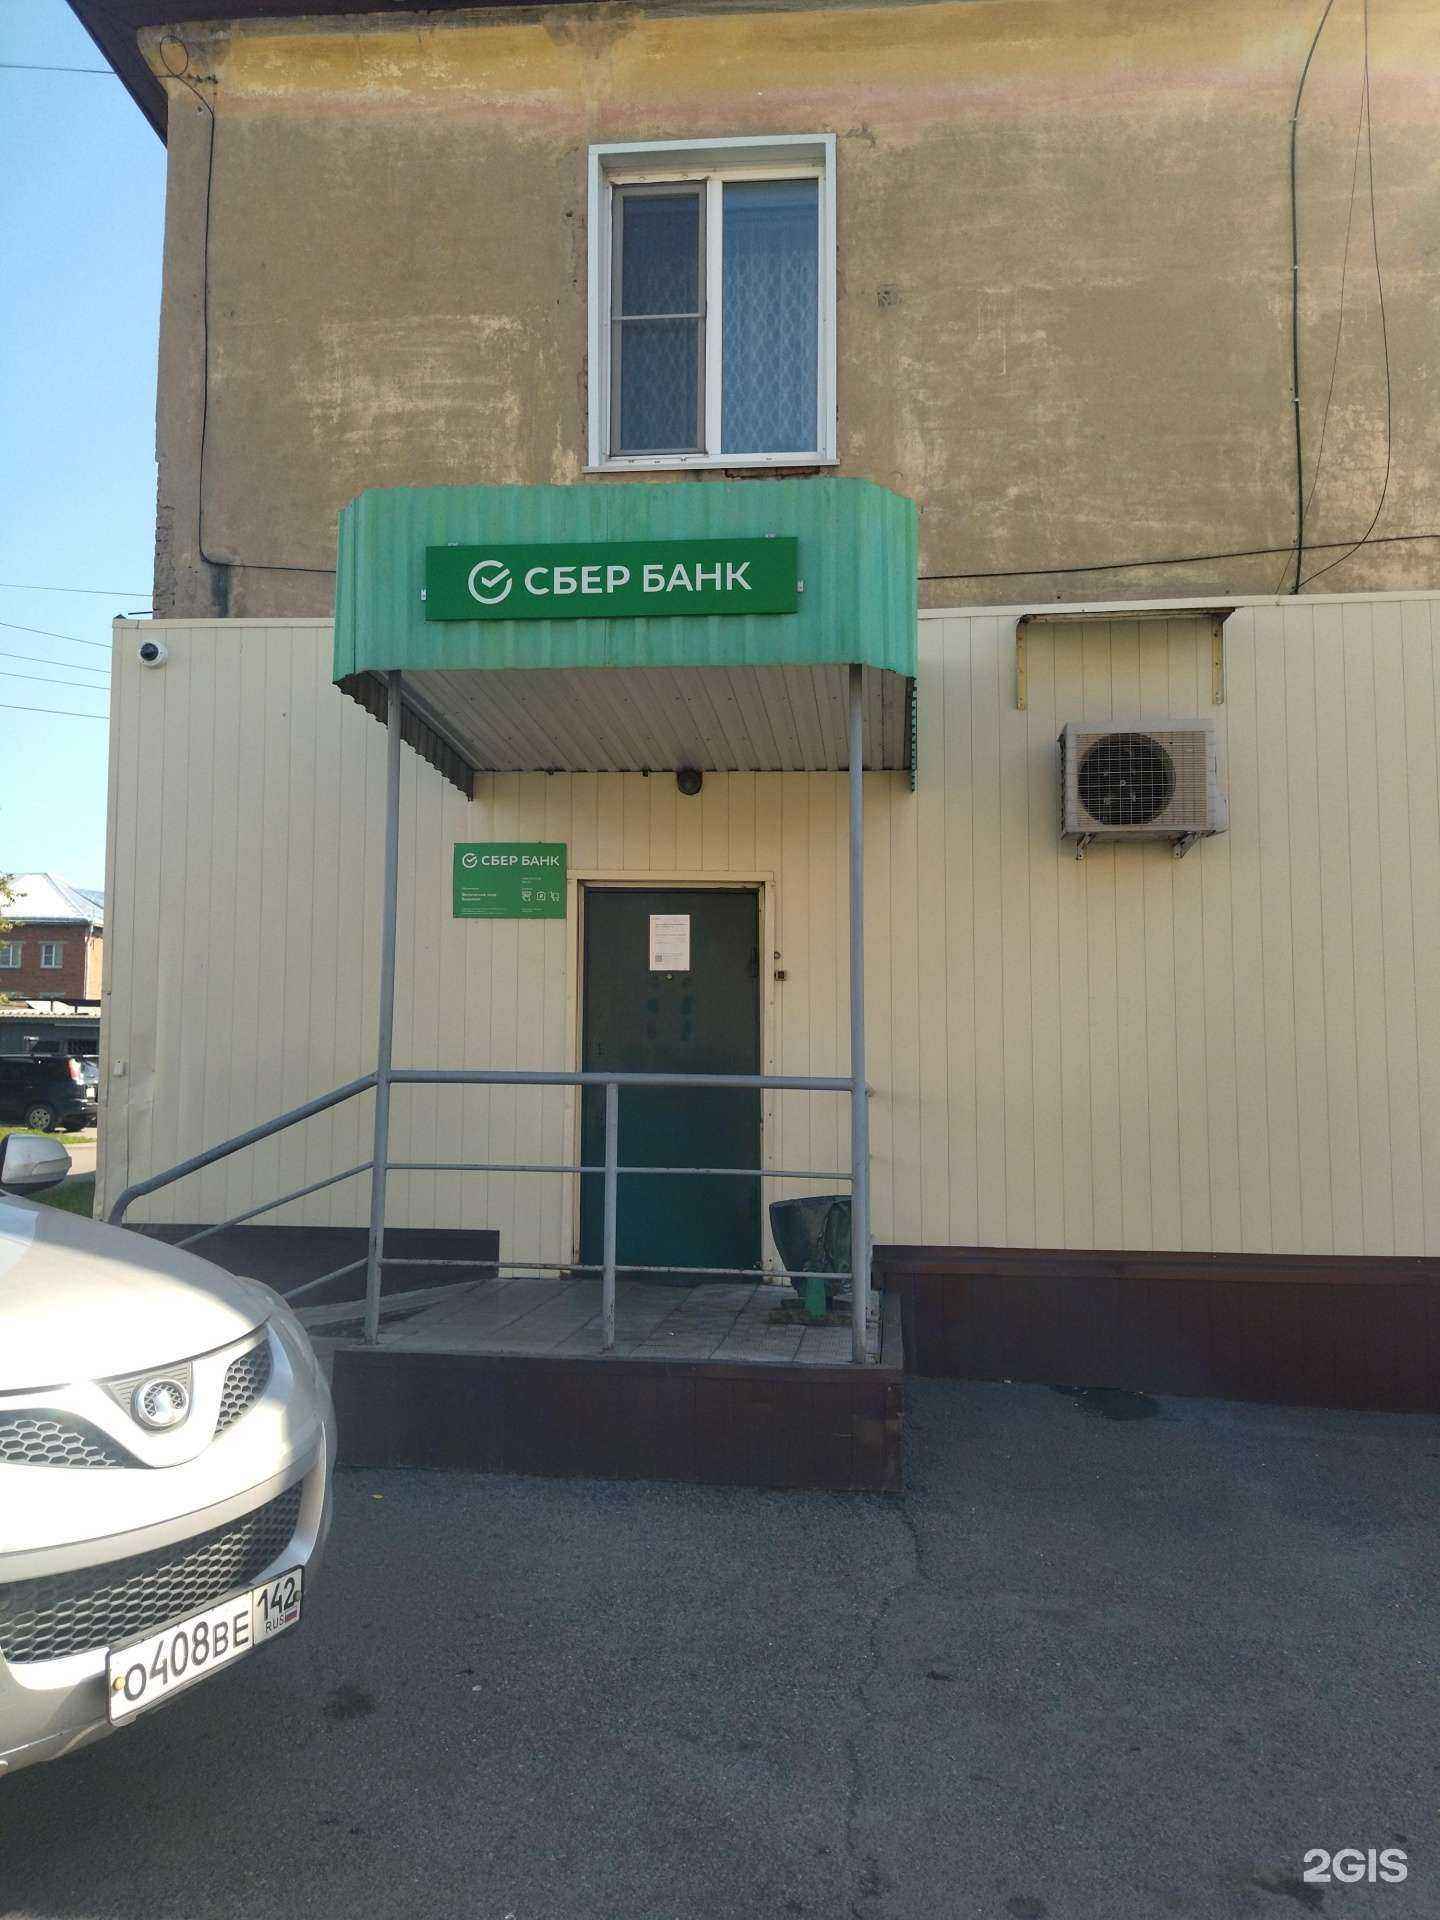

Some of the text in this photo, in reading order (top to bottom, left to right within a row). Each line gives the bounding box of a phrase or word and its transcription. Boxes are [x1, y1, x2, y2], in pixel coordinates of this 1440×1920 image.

[524, 561, 752, 595] СБЕР БАНК
[481, 855, 560, 866] СБЕР БАНК
[256, 1577, 296, 1620] 142
[265, 1618, 286, 1634] RUS
